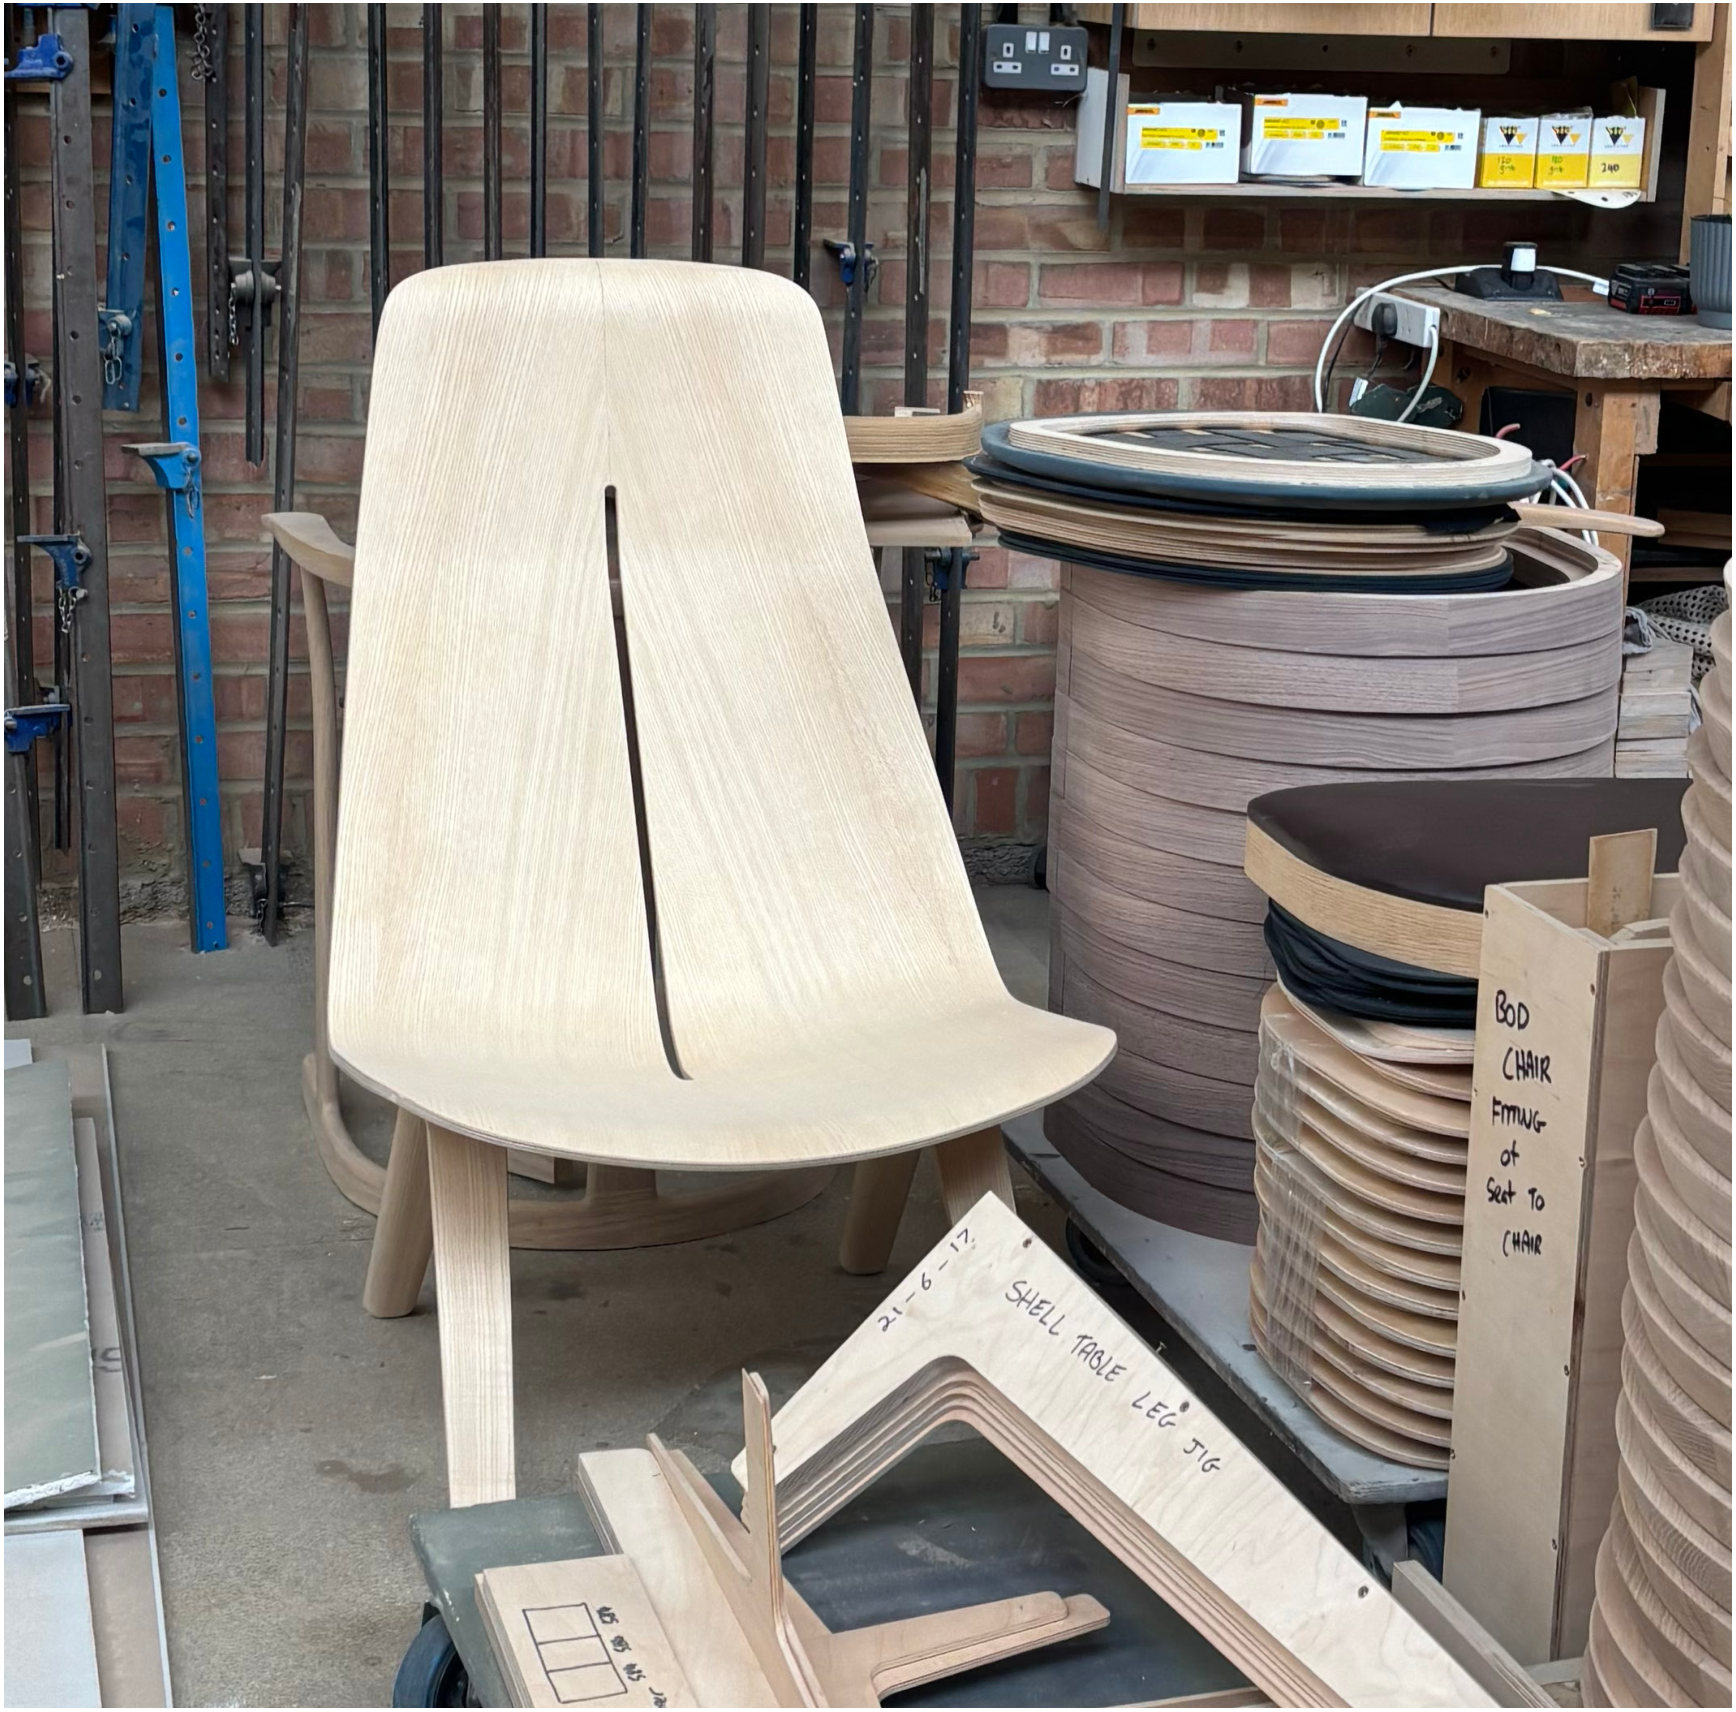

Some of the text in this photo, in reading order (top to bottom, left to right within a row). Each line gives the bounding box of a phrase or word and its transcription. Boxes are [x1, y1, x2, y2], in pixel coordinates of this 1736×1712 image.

[1601, 162, 1620, 173] 240
[1495, 989, 1530, 1030] BOD
[1502, 1047, 1552, 1084] CHAIR
[1500, 1139, 1519, 1167] of
[1502, 1229, 1542, 1257] CHAIR
[1005, 1280, 1222, 1474] SHELL TABLE LEG JIG
